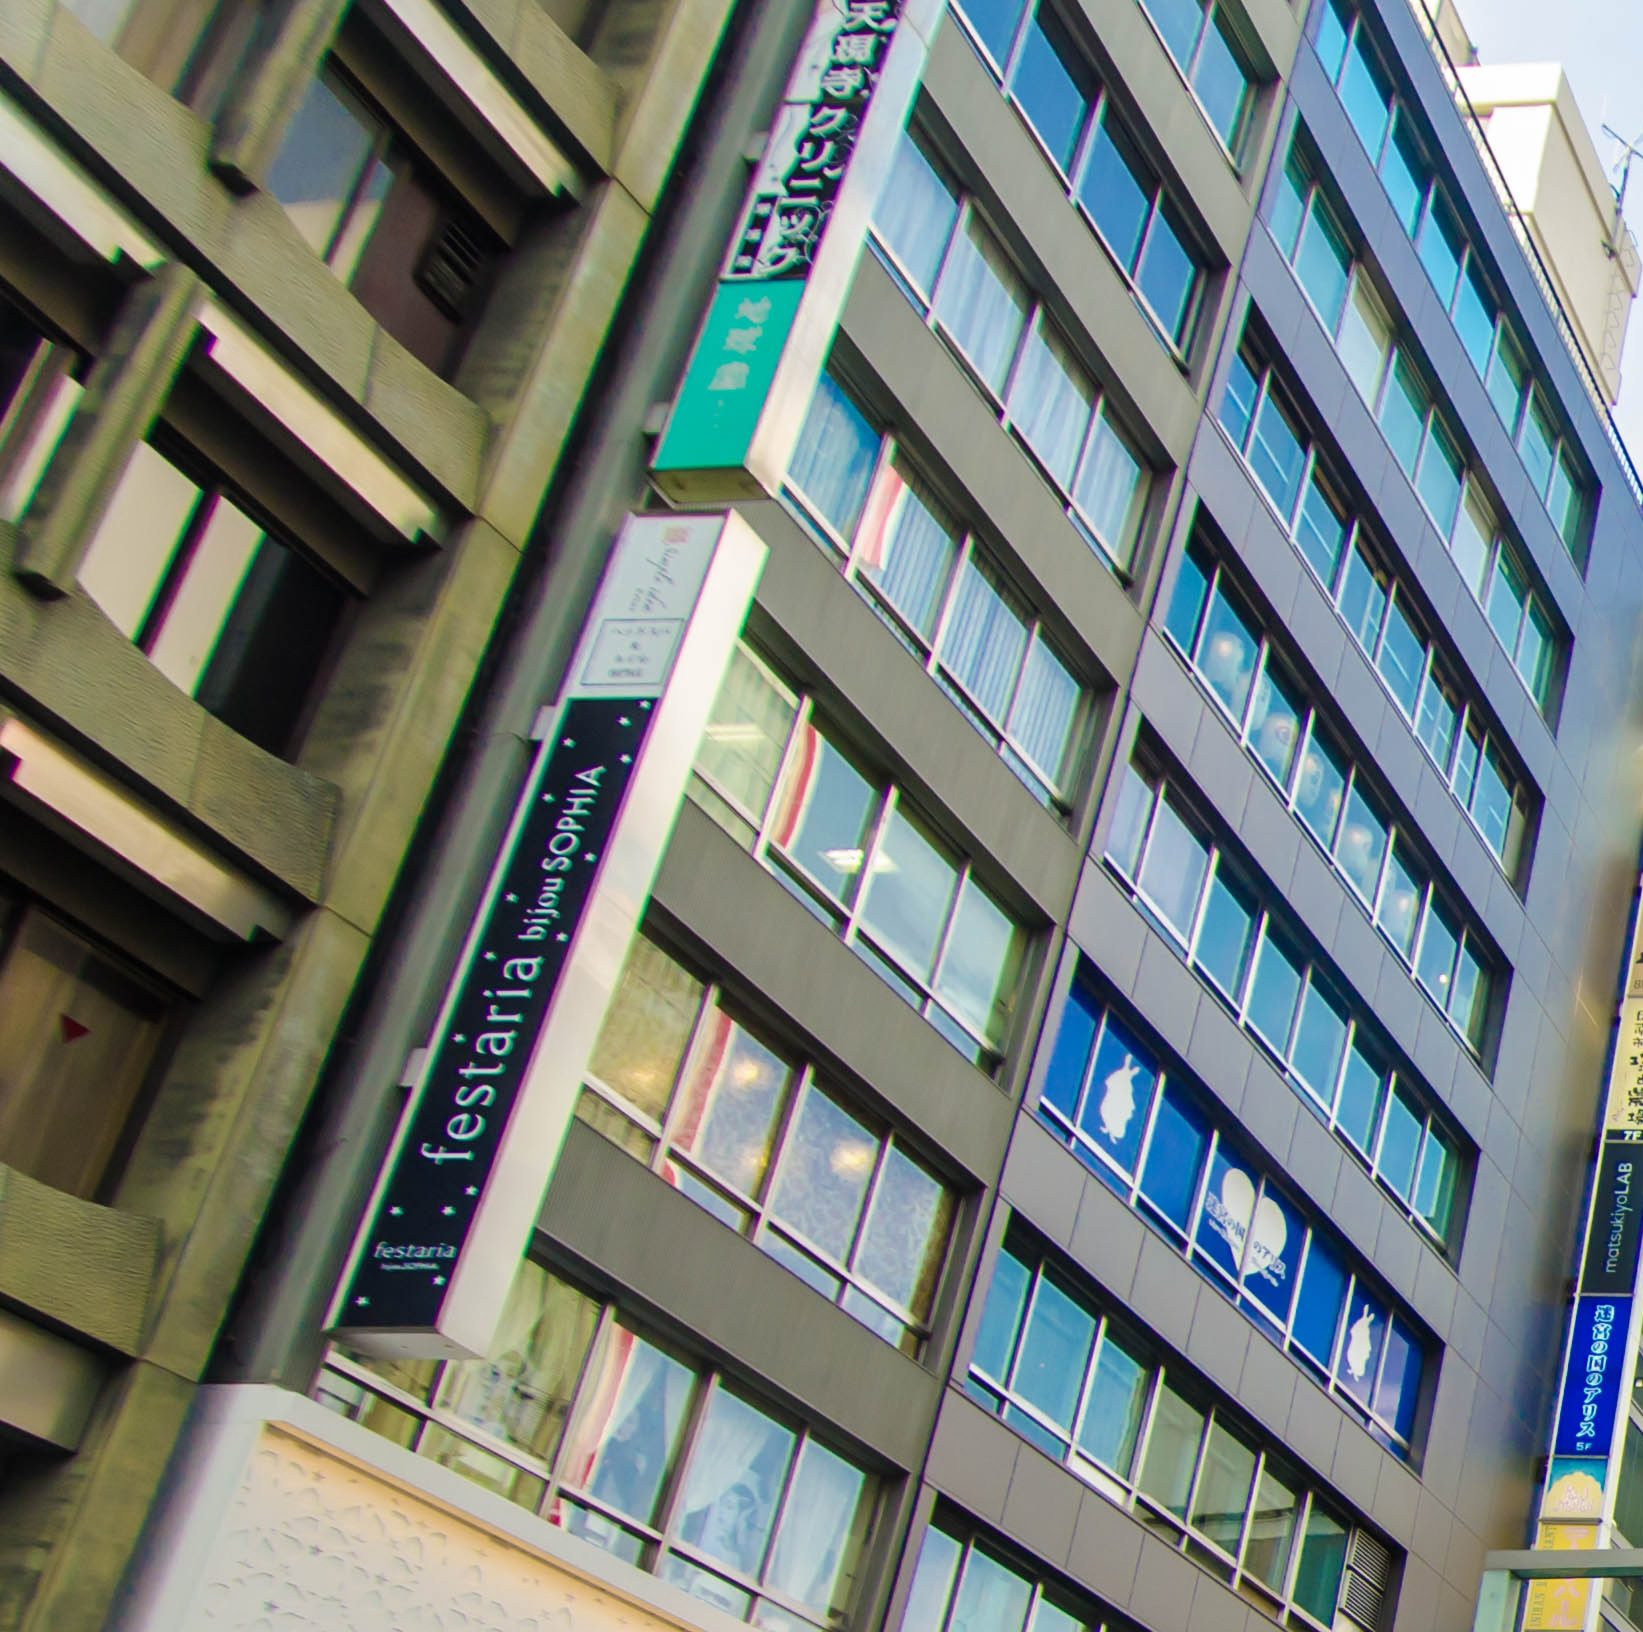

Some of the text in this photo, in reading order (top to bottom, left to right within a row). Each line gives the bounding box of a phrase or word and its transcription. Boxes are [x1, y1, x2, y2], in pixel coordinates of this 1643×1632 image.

[421, 765, 604, 1165] festaria bijou SOPHIA
[1623, 1131, 1642, 1140] 7F
[1606, 1162, 1633, 1273] matsukiyoLAB
[374, 1241, 457, 1258] festaria
[1576, 1442, 1593, 1450] 5F
